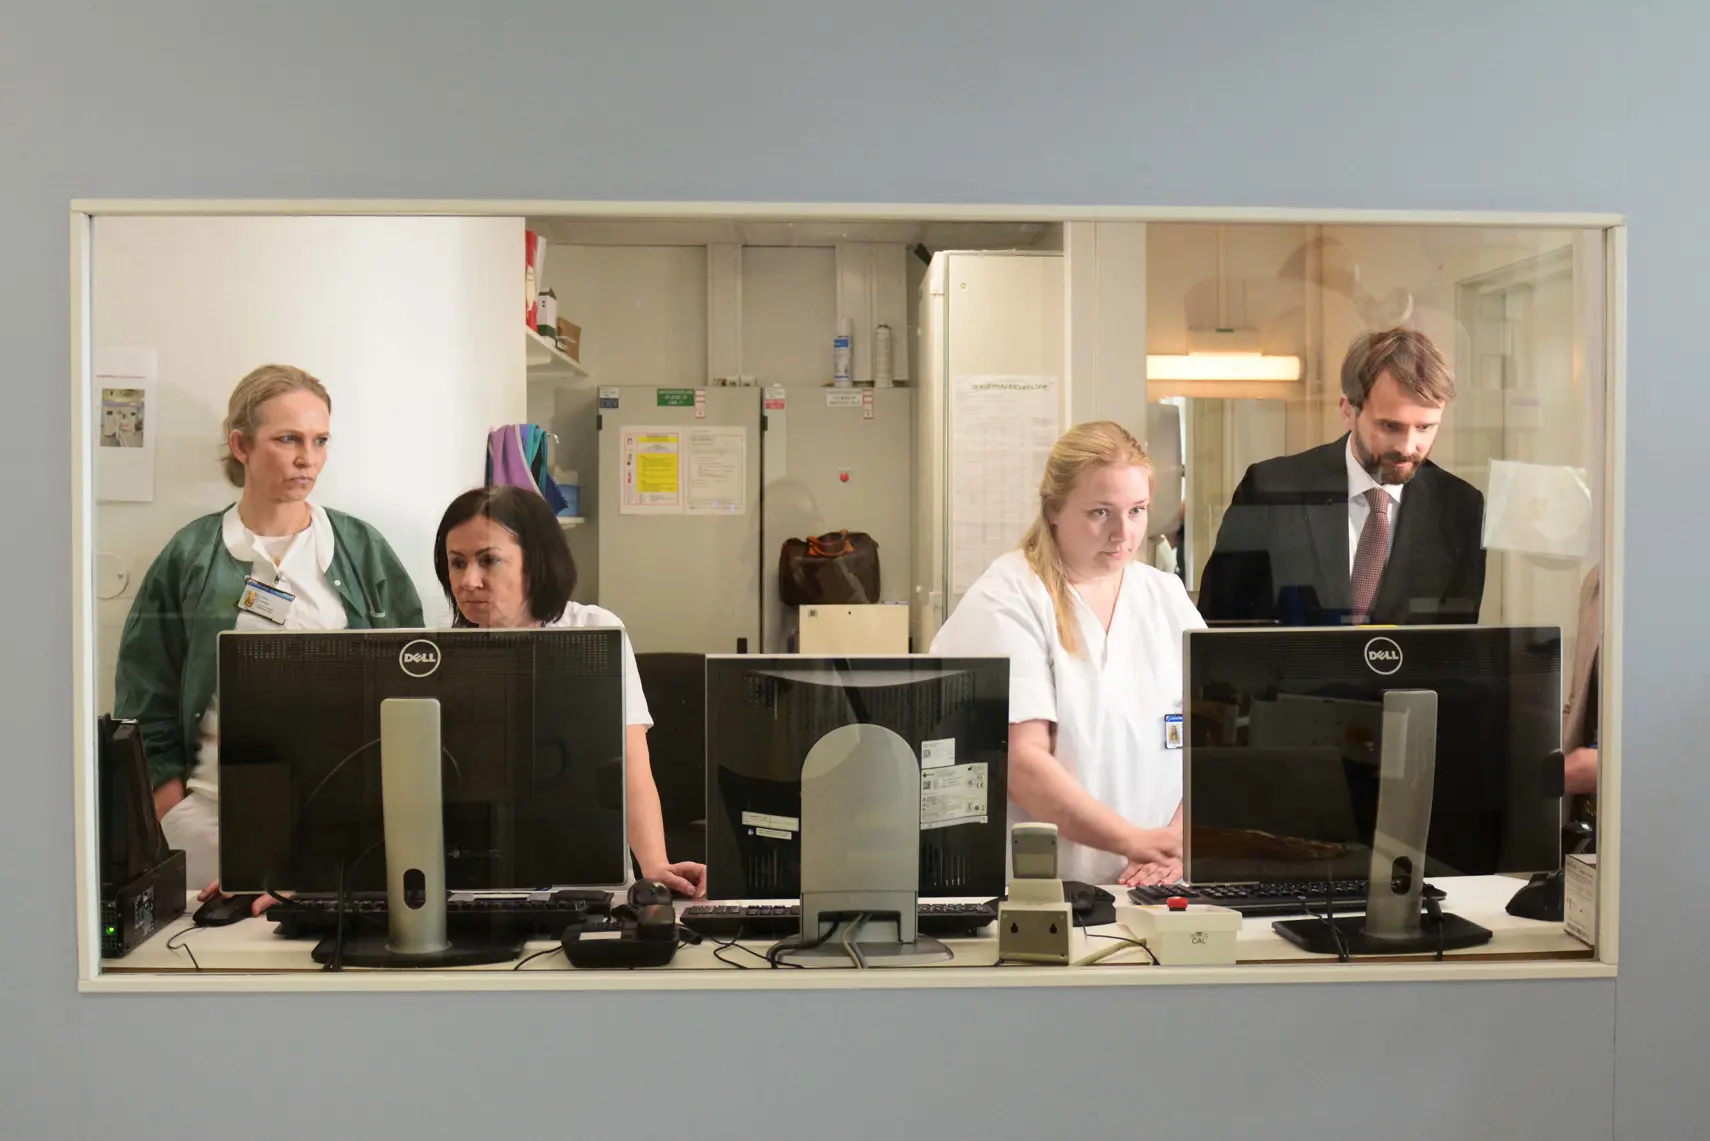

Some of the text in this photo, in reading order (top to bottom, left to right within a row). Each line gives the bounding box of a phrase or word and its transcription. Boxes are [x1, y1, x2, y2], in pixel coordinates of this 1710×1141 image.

[404, 652, 436, 663] DELL
[1368, 650, 1399, 661] DELL
[1191, 937, 1207, 945] CAL
